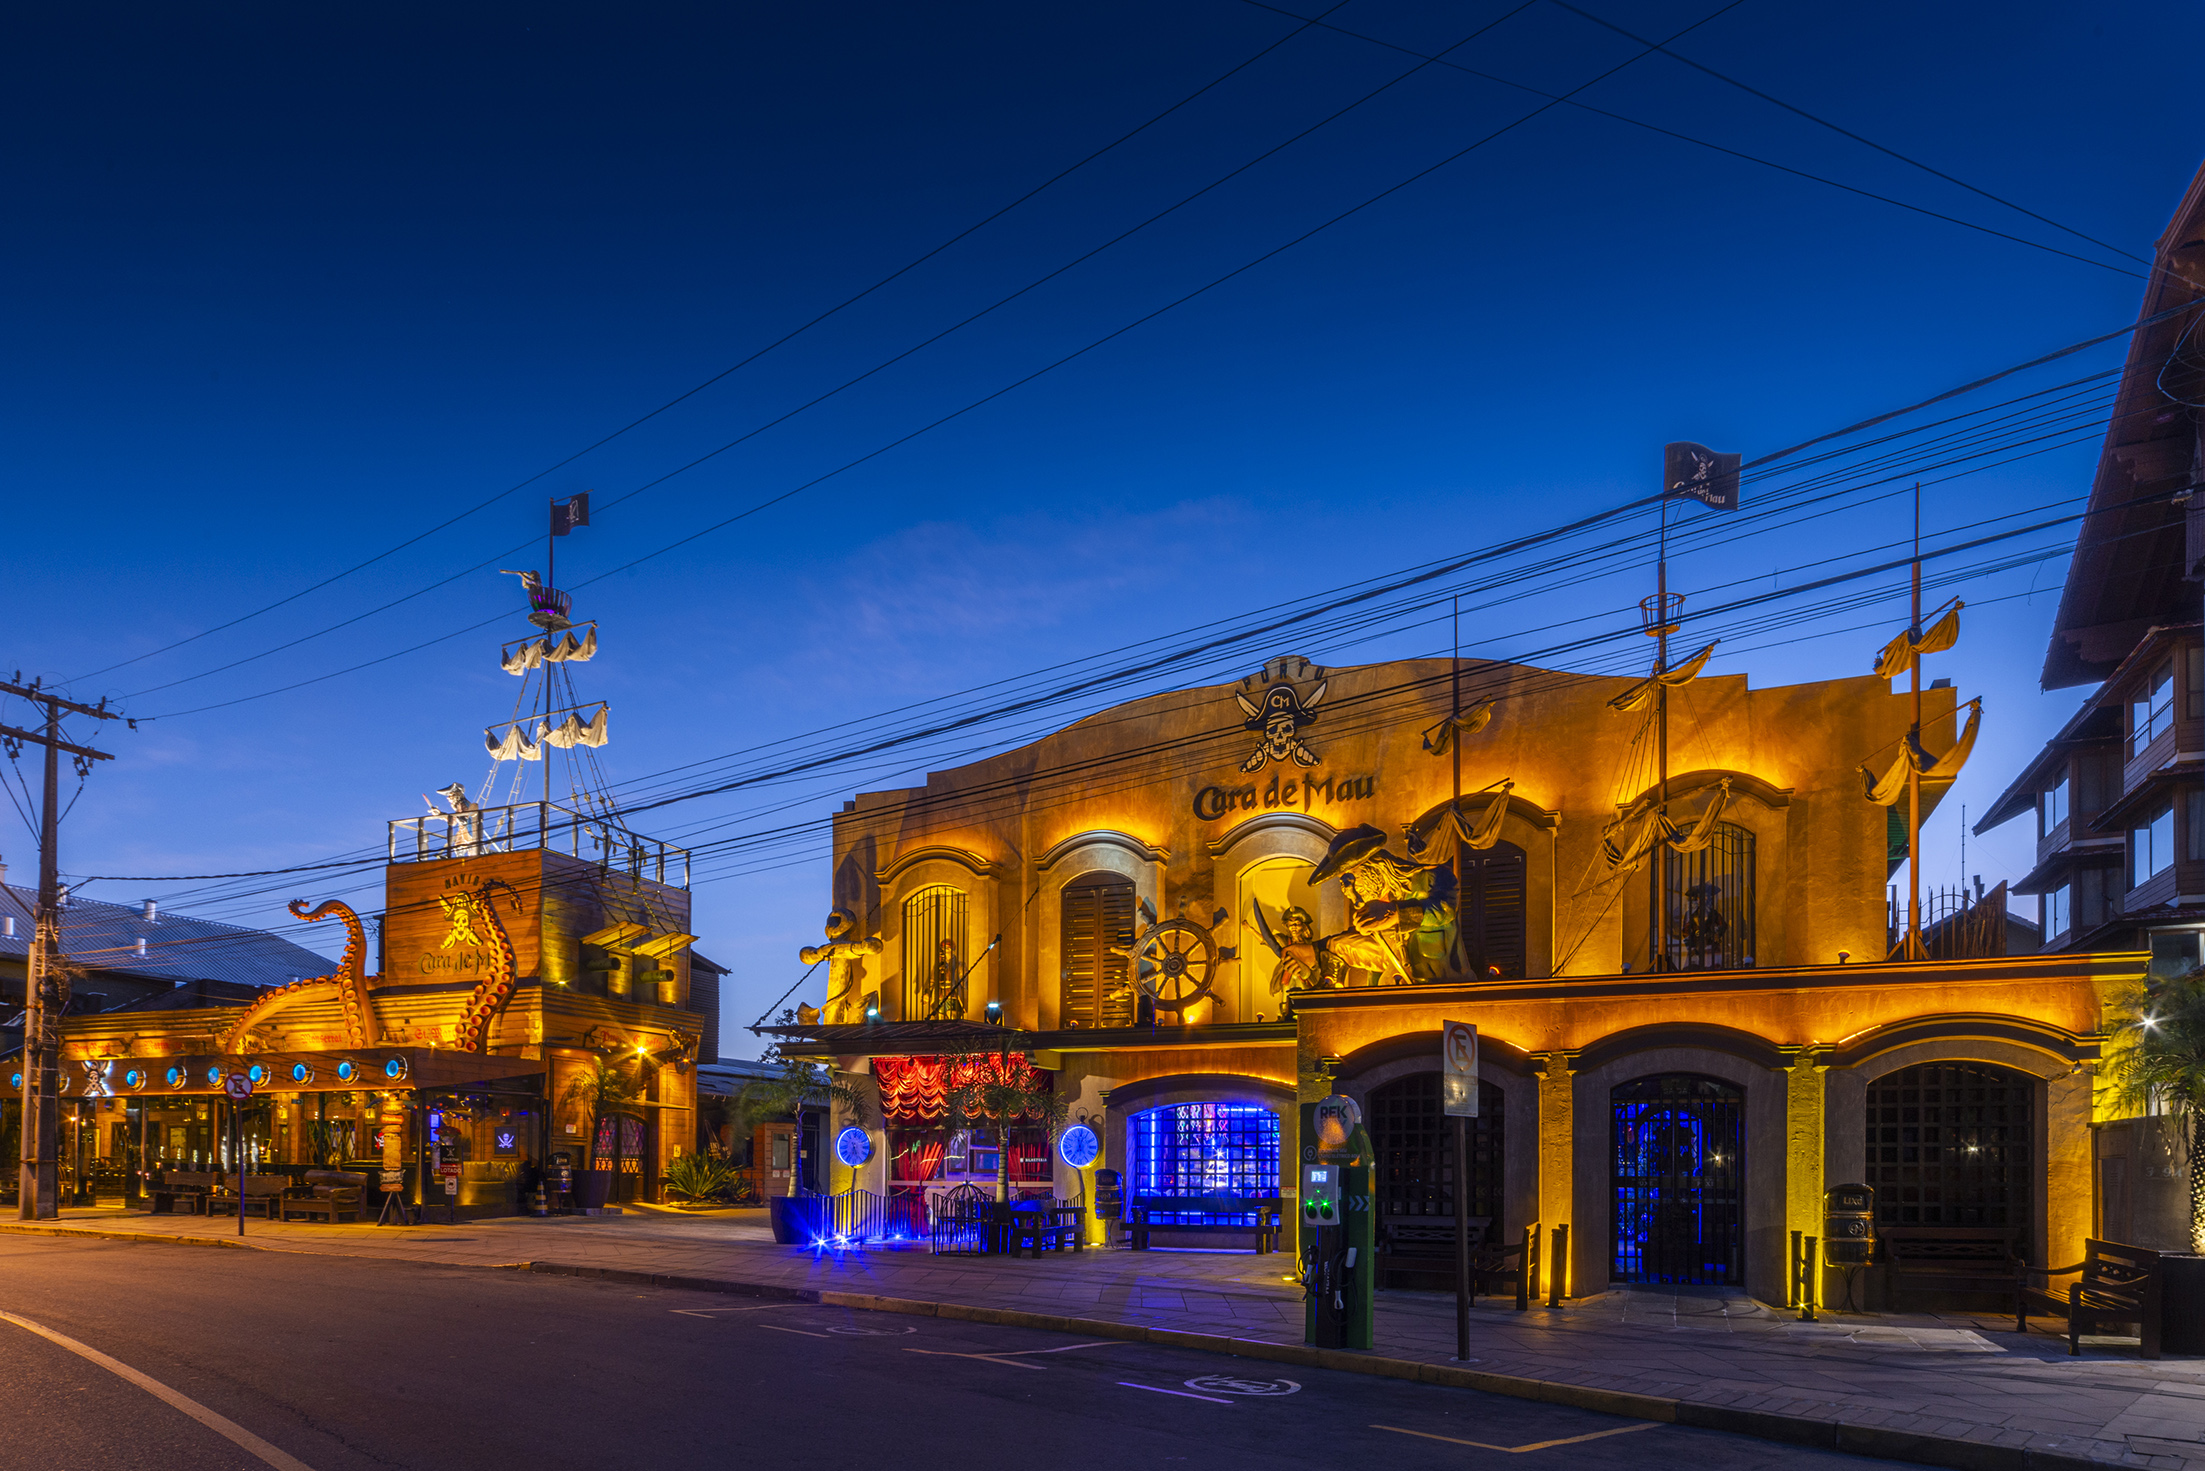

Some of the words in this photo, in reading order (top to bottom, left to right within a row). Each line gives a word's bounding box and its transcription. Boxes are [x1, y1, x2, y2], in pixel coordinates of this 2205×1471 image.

[1242, 662, 1326, 692] PORTO
[1270, 695, 1290, 708] CM
[1193, 786, 1259, 821] Cara
[1264, 775, 1299, 810] de
[1302, 773, 1375, 814] Mau
[444, 874, 480, 890] NAVIO
[418, 952, 451, 976] Cara
[454, 952, 472, 973] de
[1320, 1105, 1347, 1119] REK
[1843, 1196, 1863, 1206] LIXO
